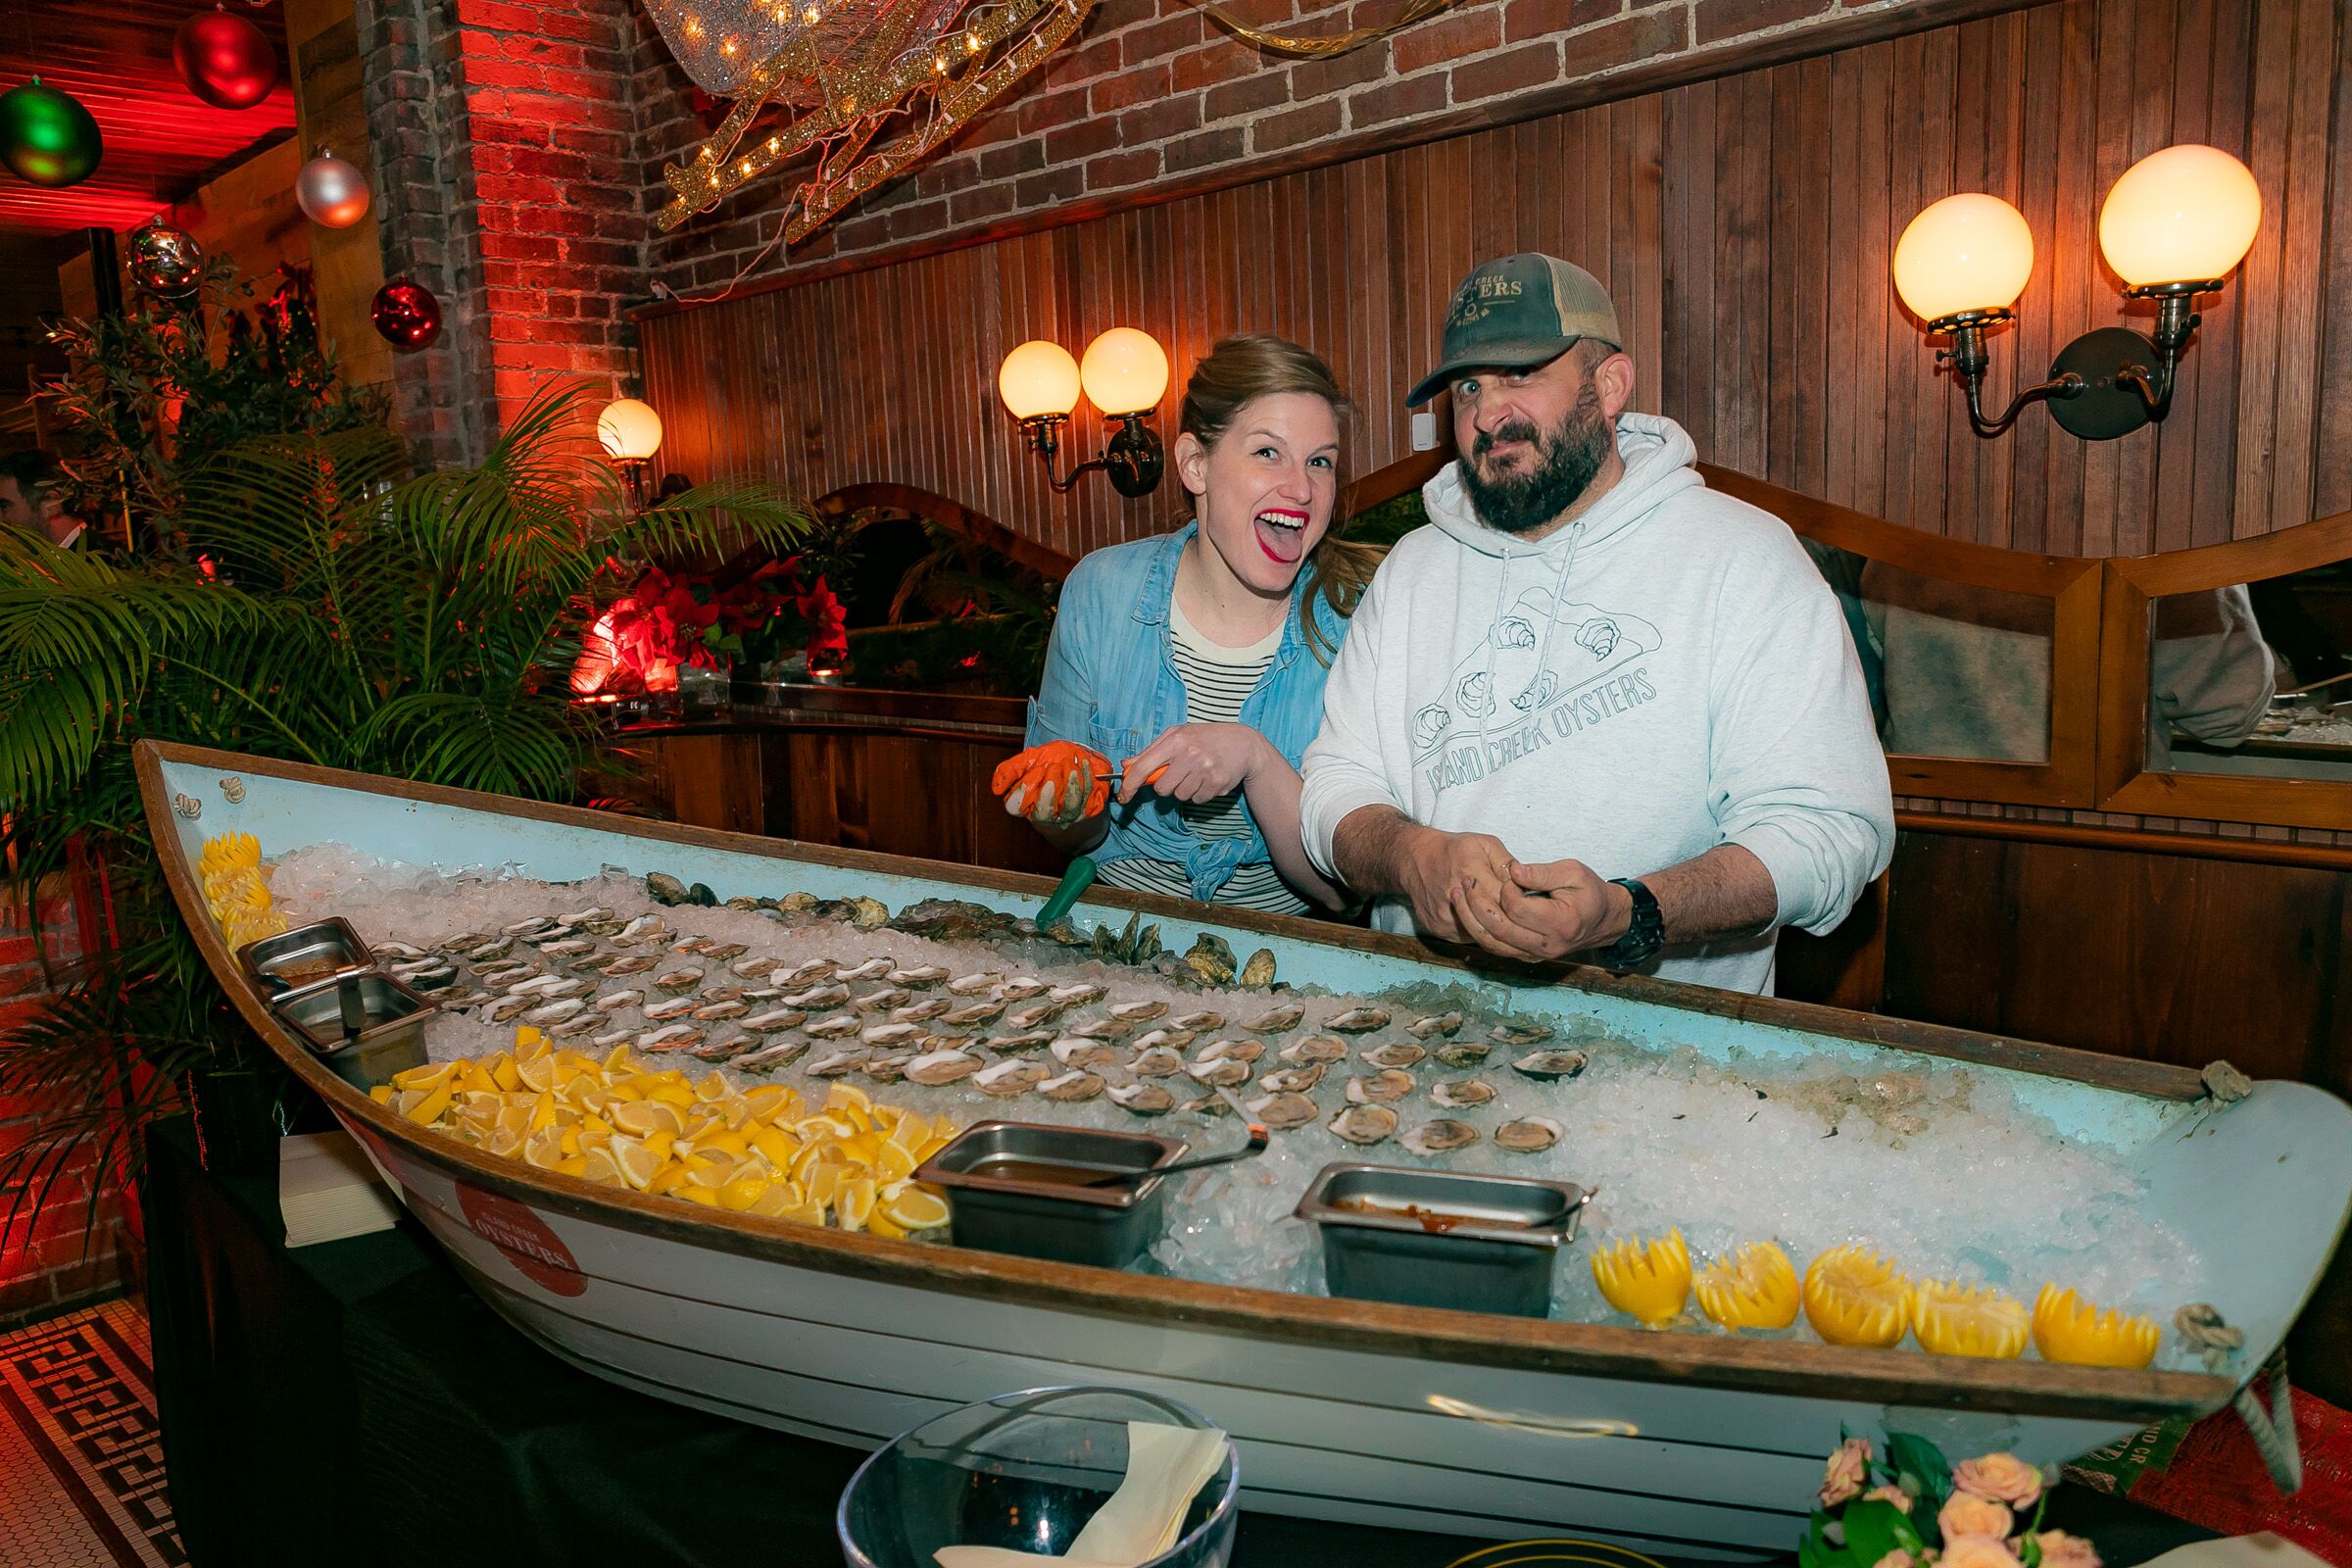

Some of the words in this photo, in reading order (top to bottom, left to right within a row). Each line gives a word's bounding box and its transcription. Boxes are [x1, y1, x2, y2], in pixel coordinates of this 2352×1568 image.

[1475, 274, 1505, 286] CREEK
[1551, 667, 1657, 738] OYSTERS
[475, 1218, 574, 1269] OYSTERS
